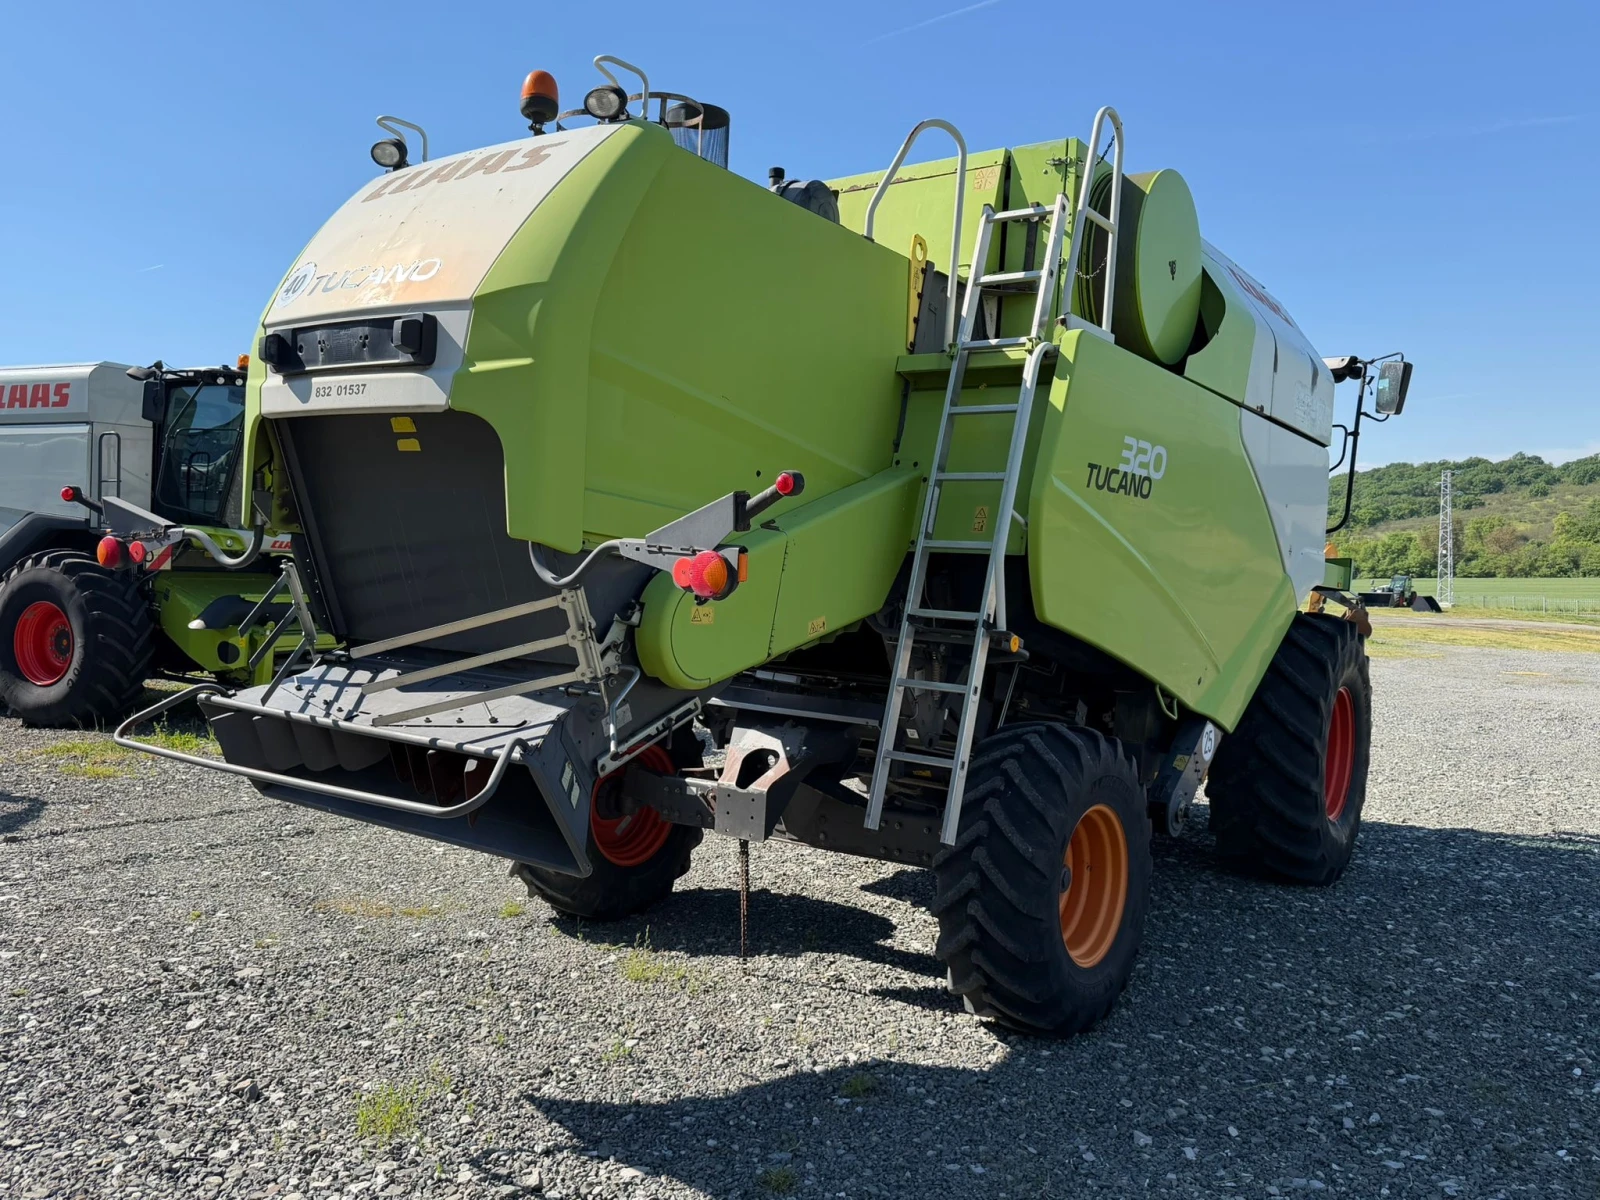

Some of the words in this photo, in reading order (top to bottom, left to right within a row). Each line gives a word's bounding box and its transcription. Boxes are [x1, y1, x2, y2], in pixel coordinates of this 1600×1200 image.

[361, 141, 569, 203] CLAAS
[284, 274, 306, 296] 40
[307, 258, 442, 297] TUCANO
[0, 382, 71, 409] LAAS
[315, 387, 332, 398] 832
[336, 383, 367, 397] 01537
[1118, 435, 1167, 480] 320
[1086, 462, 1153, 500] TUCANO
[1203, 730, 1213, 754] 25
